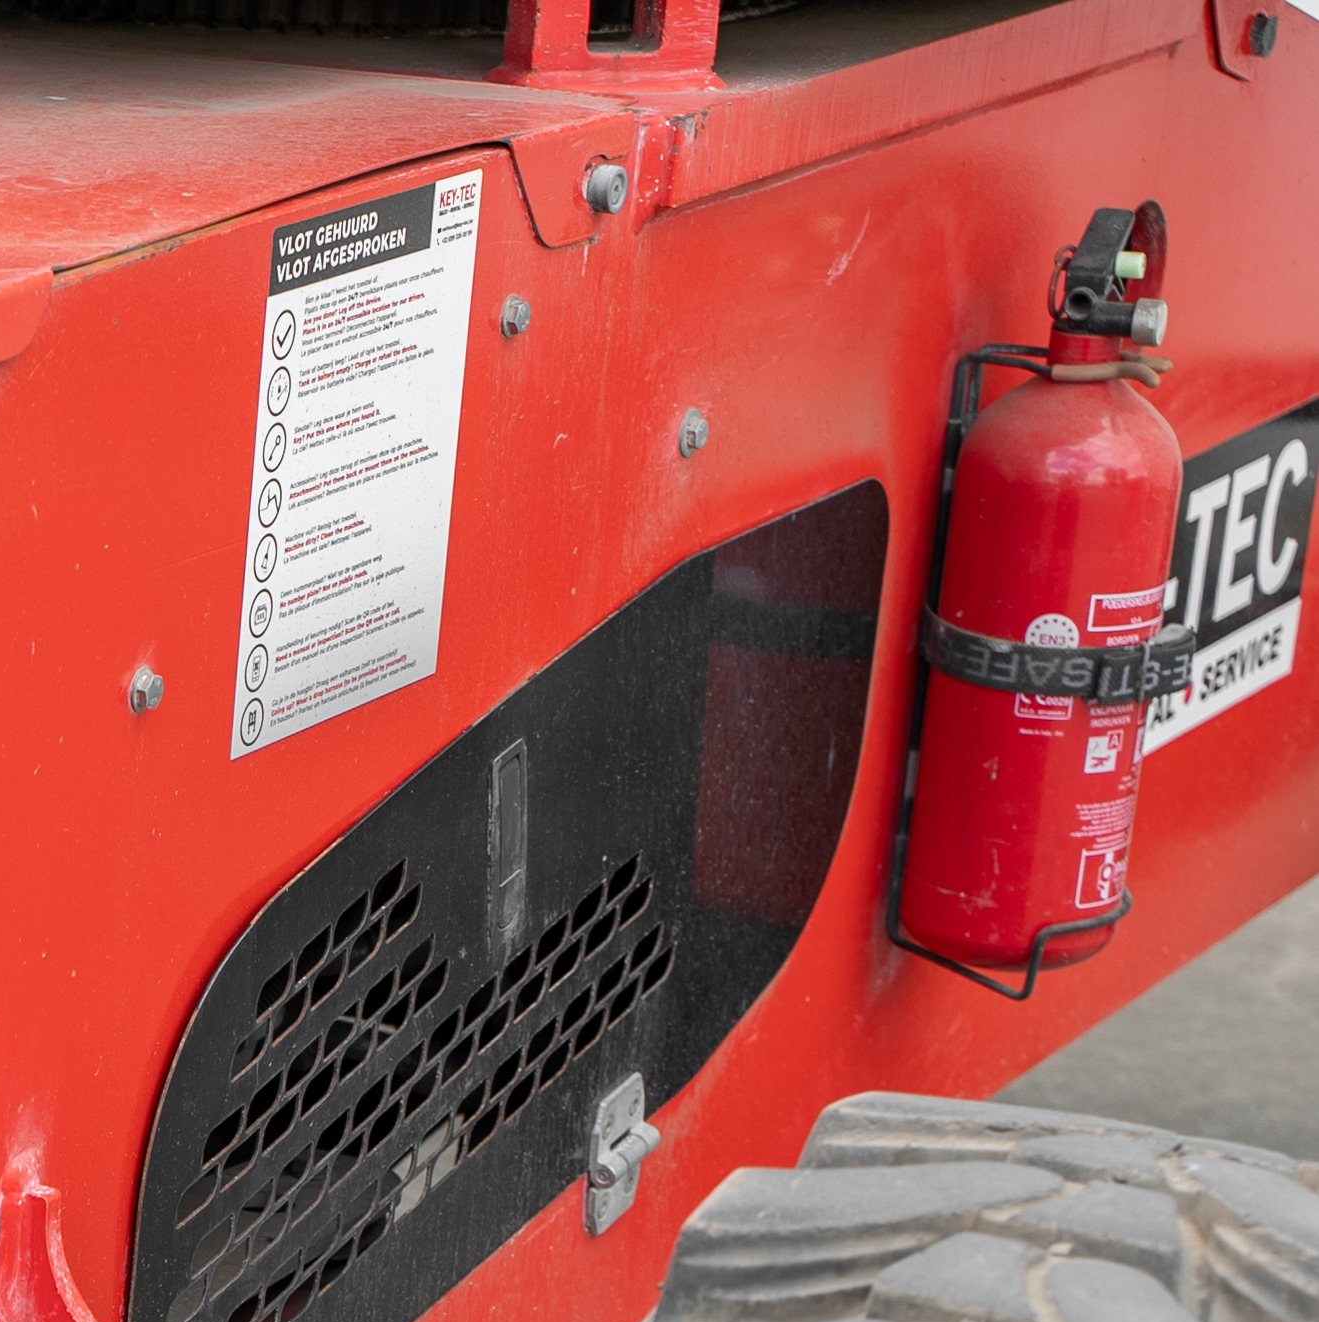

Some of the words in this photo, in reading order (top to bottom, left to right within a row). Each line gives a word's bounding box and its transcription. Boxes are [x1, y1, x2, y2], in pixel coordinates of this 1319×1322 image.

[439, 183, 477, 208] KEY-TEC
[277, 255, 312, 283] VLOT
[312, 227, 407, 273] AFGESPROKEN
[279, 230, 314, 257] VLOT
[315, 211, 379, 246] GEHUURD
[1163, 438, 1308, 635] -TEC
[1039, 633, 1066, 646] EN3
[1200, 622, 1285, 702] SERVICE
[1109, 733, 1120, 749] A
